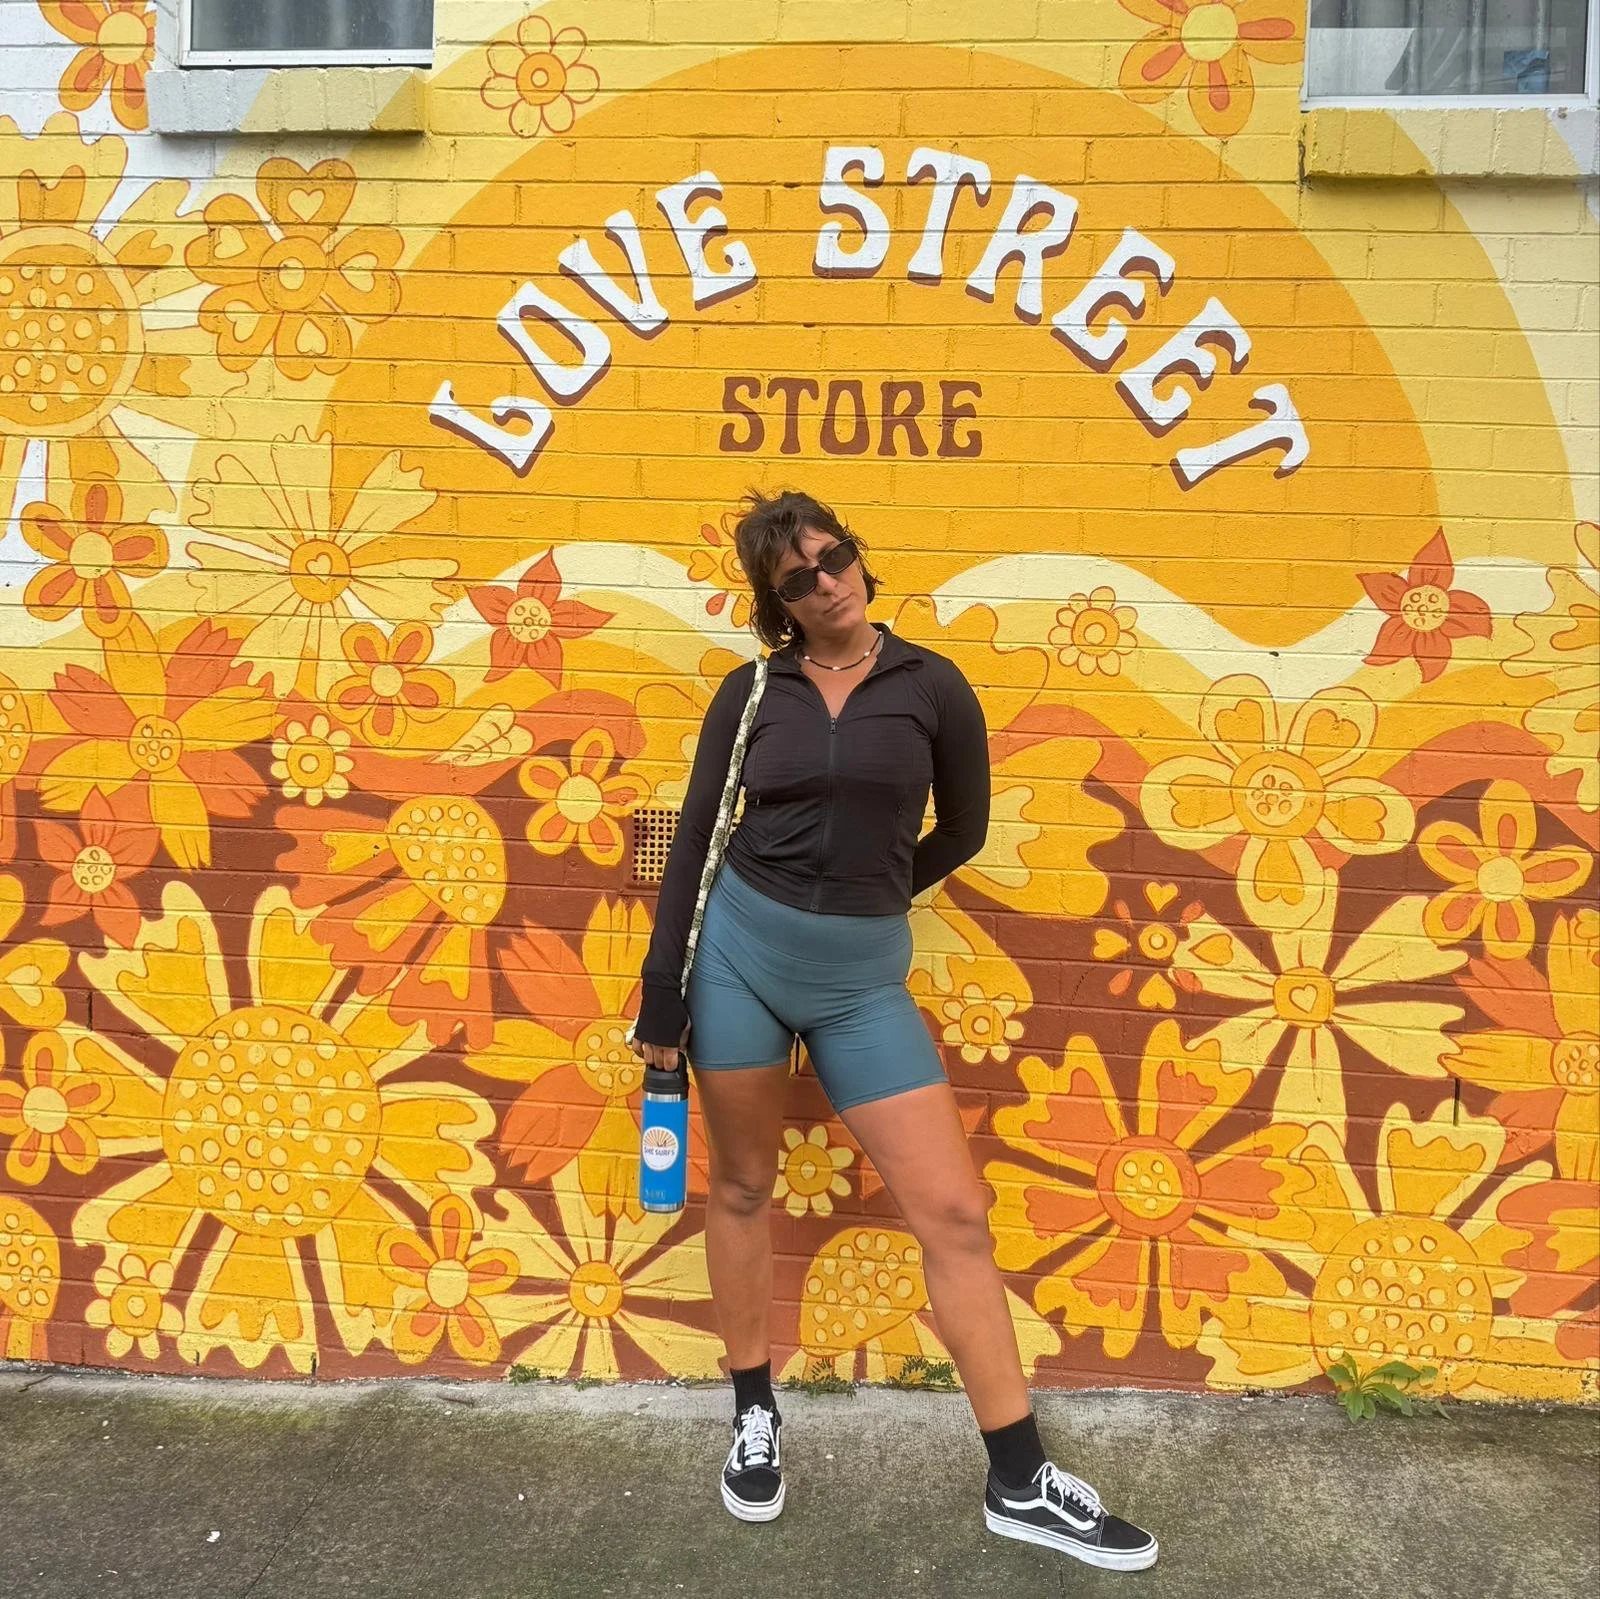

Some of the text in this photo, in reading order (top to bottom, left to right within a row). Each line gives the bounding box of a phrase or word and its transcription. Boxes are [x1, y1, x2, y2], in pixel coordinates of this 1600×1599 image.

[428, 146, 1310, 492] LOVE STREET
[719, 376, 982, 458] STORE
